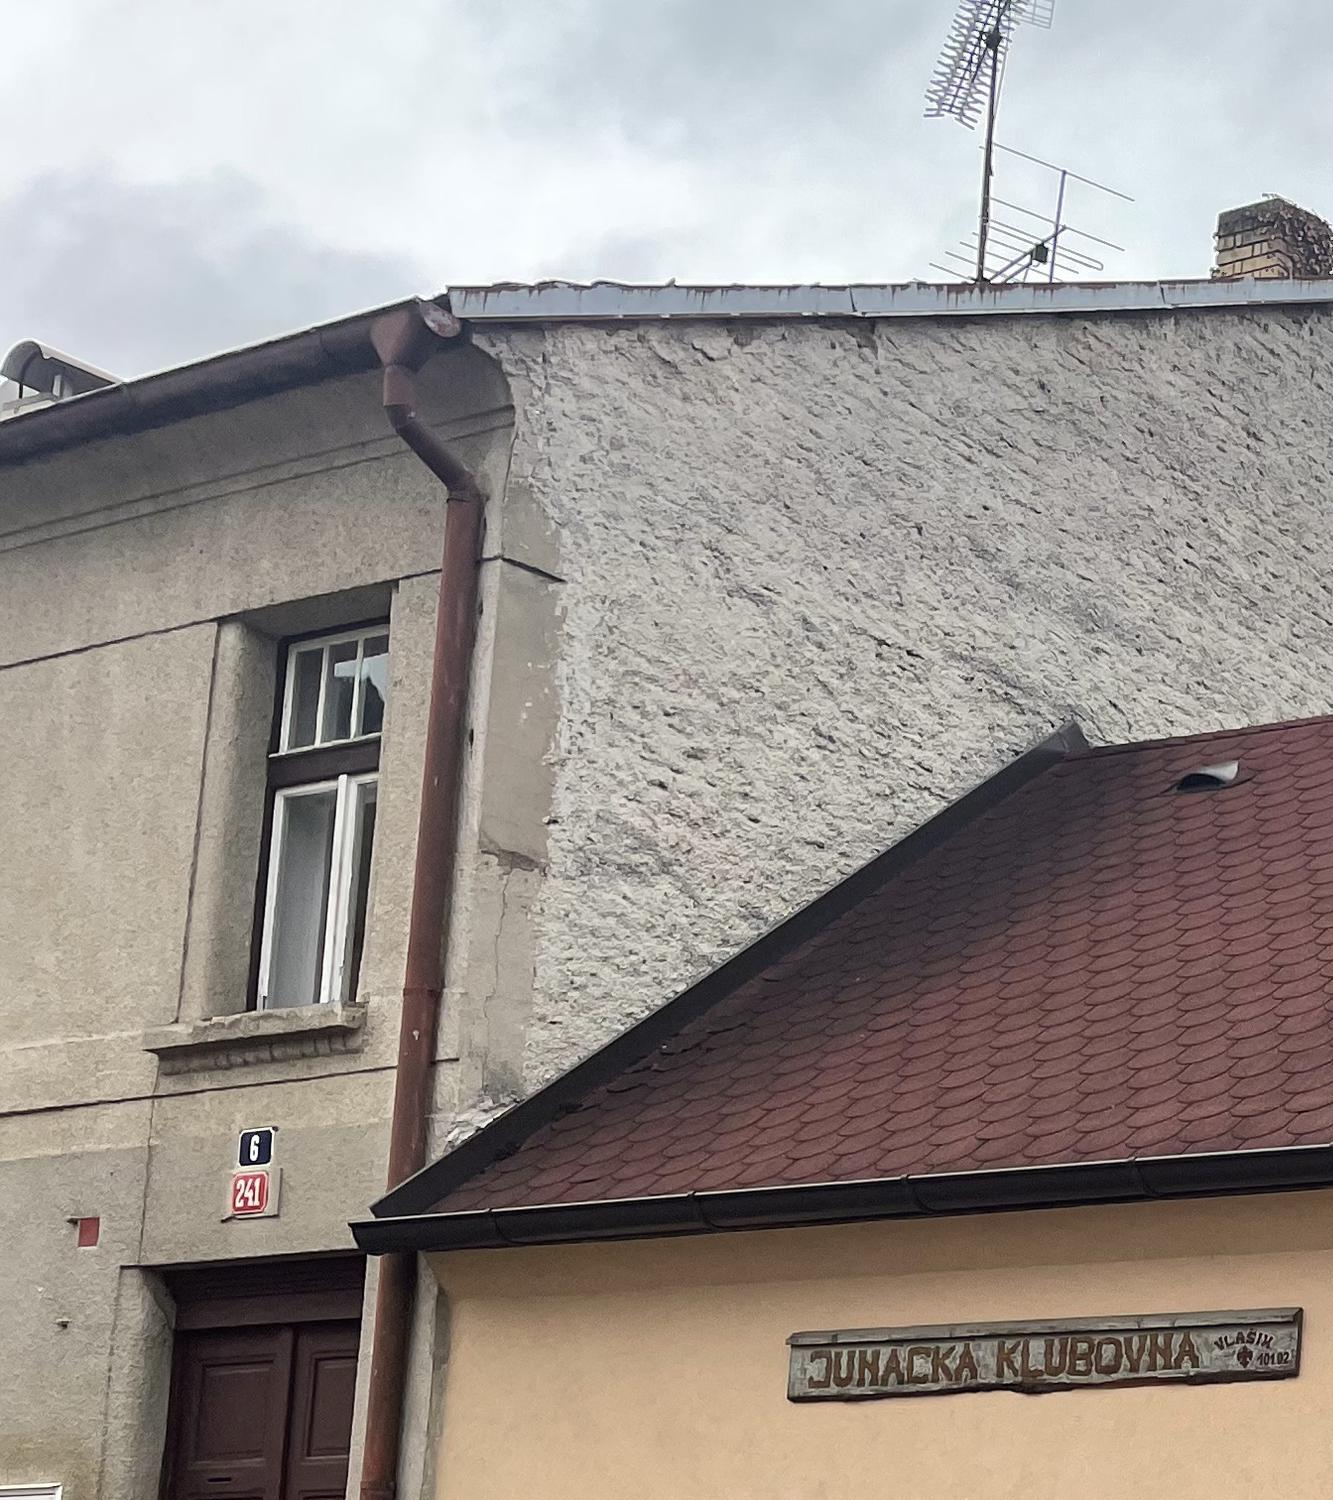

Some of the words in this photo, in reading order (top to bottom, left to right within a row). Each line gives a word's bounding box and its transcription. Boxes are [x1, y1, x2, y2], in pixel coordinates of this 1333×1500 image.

[249, 1134, 260, 1162] 6
[234, 1177, 261, 1208] 241
[996, 1331, 1200, 1378] KLUBOVNA
